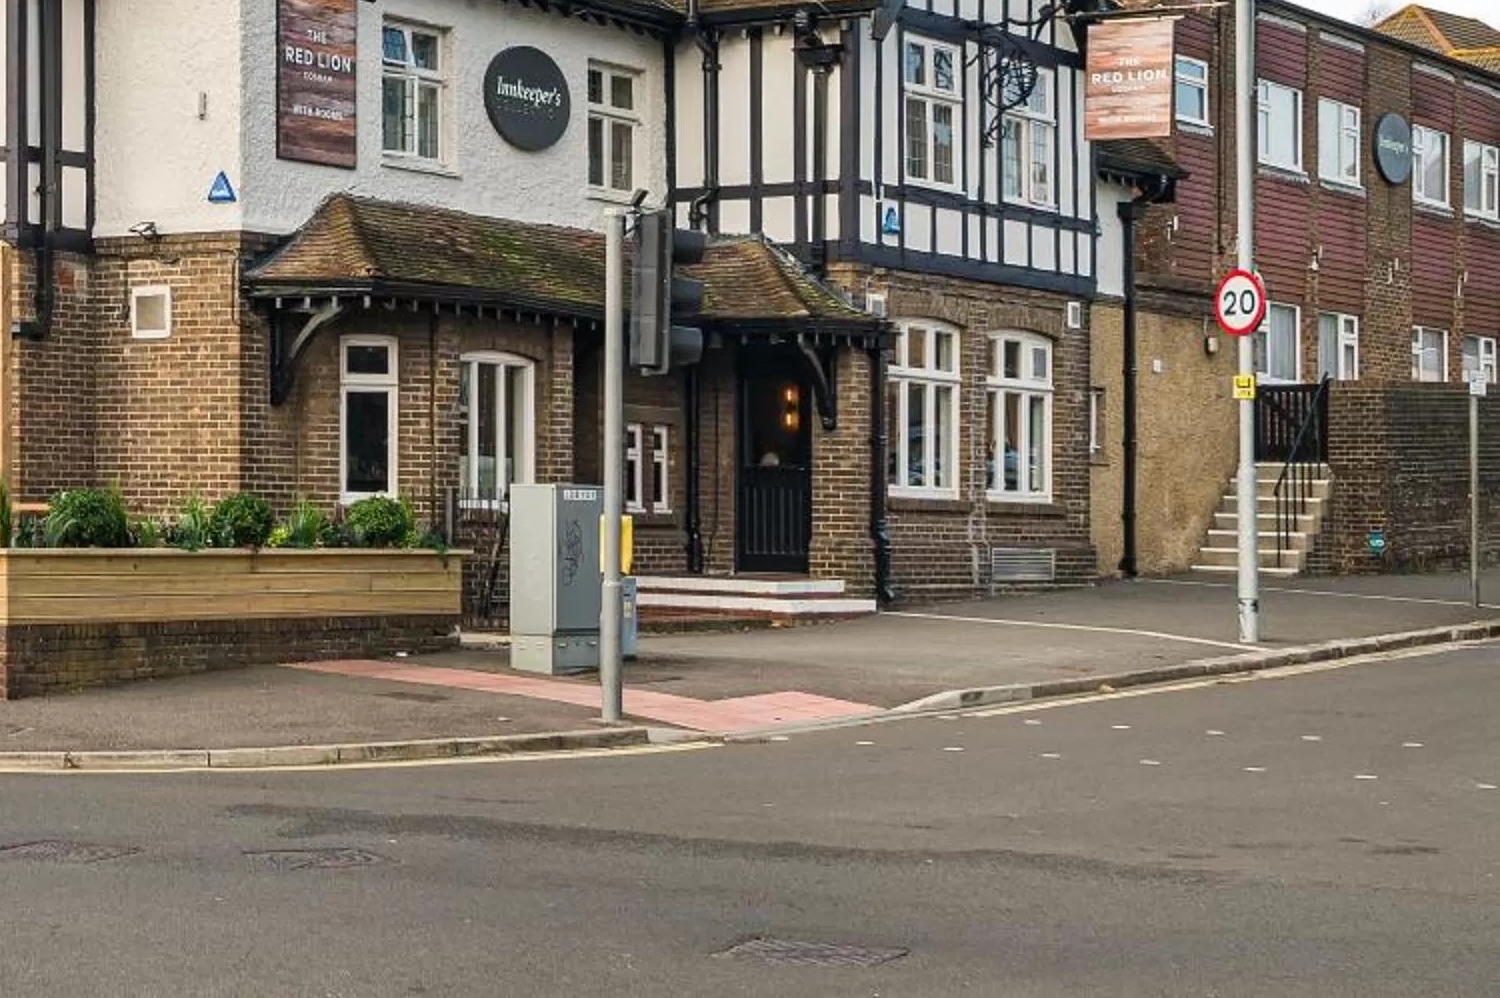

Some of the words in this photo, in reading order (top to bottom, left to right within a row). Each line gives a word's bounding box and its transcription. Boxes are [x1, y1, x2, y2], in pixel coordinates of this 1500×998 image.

[306, 29, 328, 44] THE
[284, 45, 314, 66] RED
[317, 51, 352, 74] LION
[1091, 71, 1124, 85] RED
[1127, 69, 1168, 82] LION
[496, 75, 562, 107] Innkeeper's
[1223, 289, 1256, 316] 20
